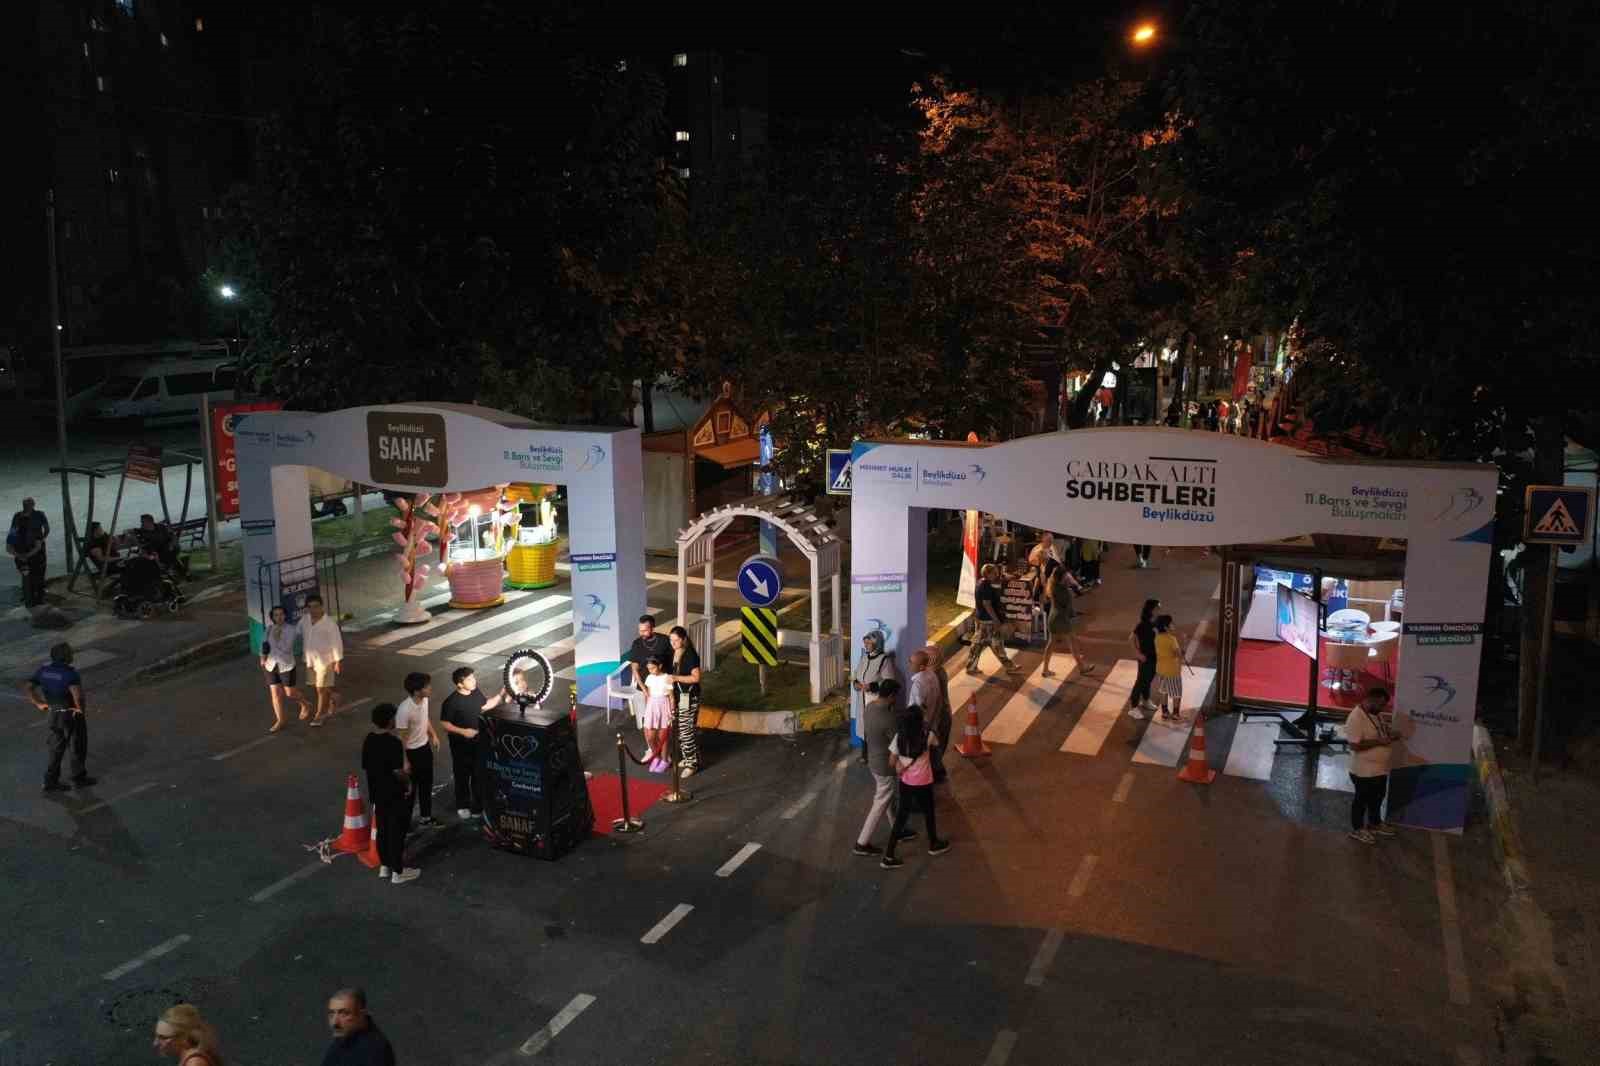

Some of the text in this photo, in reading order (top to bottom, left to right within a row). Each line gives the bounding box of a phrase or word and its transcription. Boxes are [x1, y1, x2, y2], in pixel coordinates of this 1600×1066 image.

[379, 435, 435, 462] SAHAF
[922, 469, 967, 480] Beylikdüzü
[1066, 461, 1216, 485] ÇARDAK ALTI
[1351, 486, 1408, 498] Beylikdüzü
[1354, 499, 1369, 508] ve
[1372, 497, 1407, 513] Sevgi
[1142, 506, 1215, 523] Beylikdüzü
